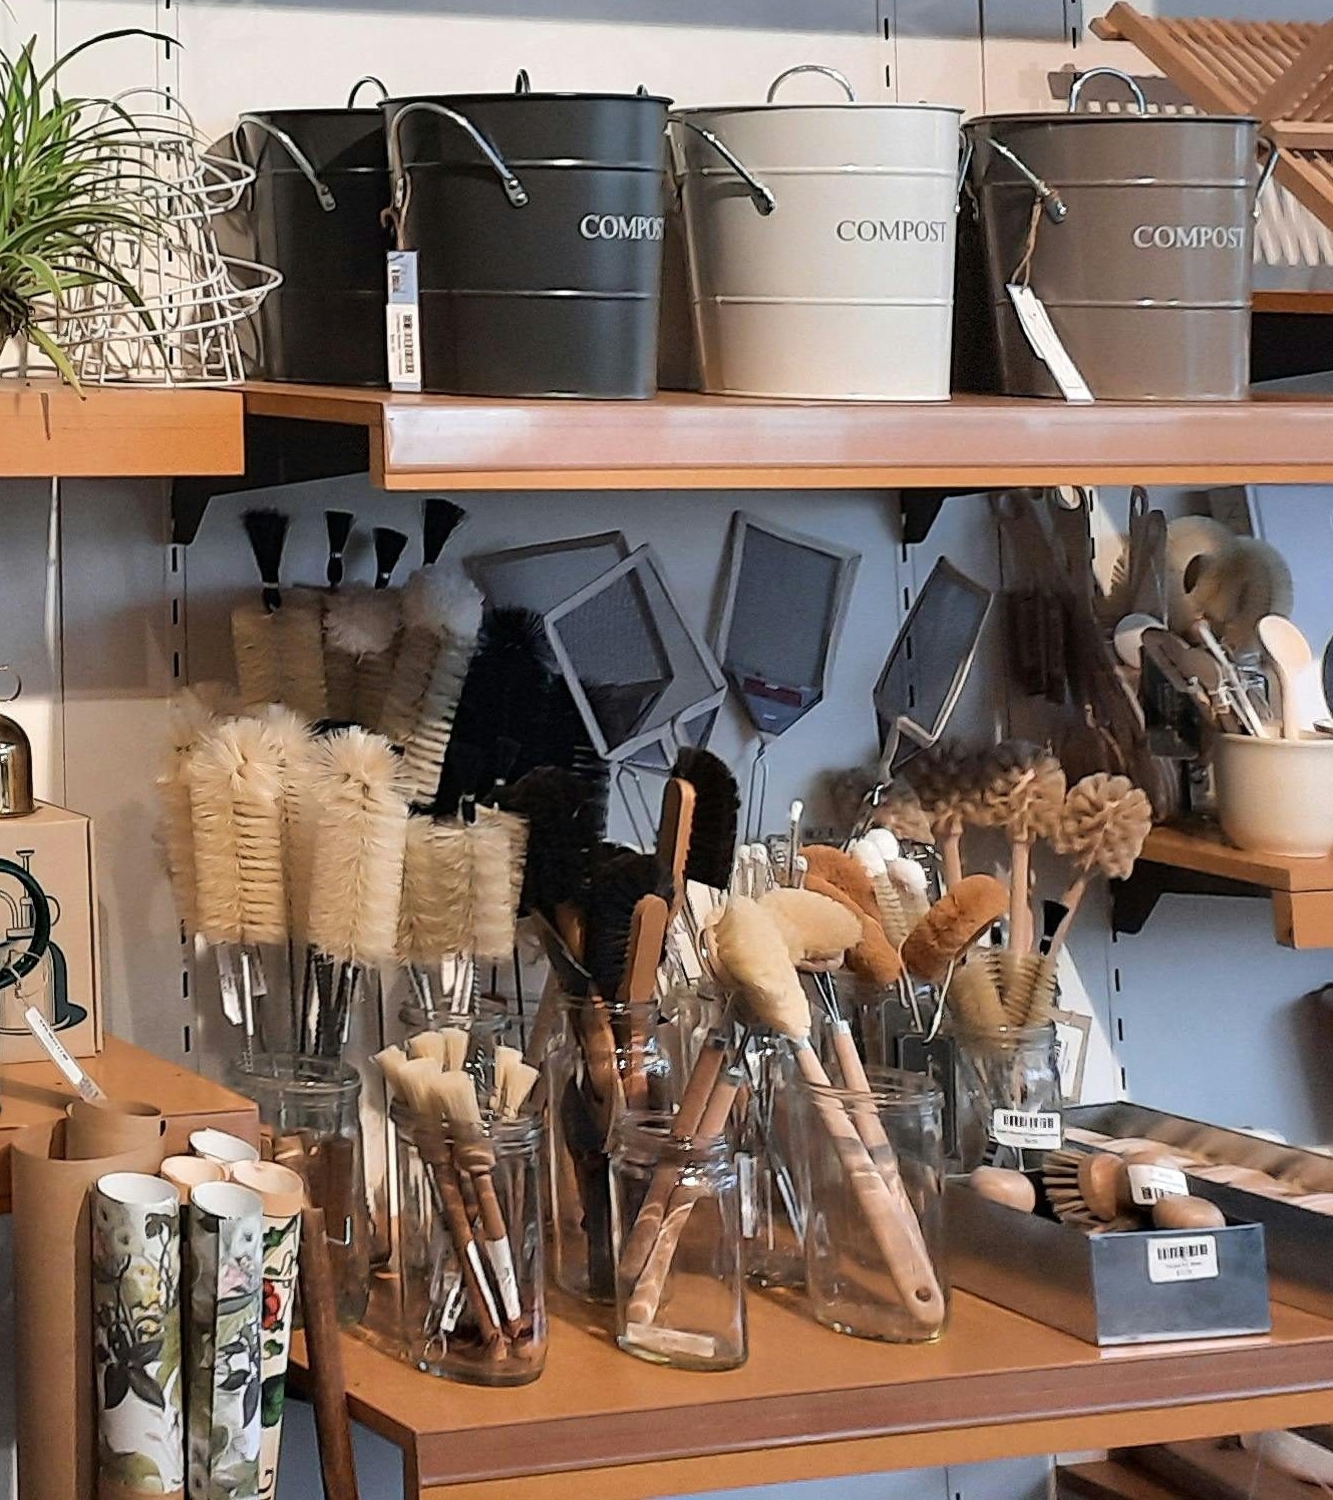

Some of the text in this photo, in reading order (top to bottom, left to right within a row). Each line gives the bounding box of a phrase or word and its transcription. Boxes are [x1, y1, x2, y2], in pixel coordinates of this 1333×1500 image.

[580, 214, 665, 240] COMPOS
[836, 220, 947, 242] COMPOST
[1133, 225, 1245, 249] COMPOST
